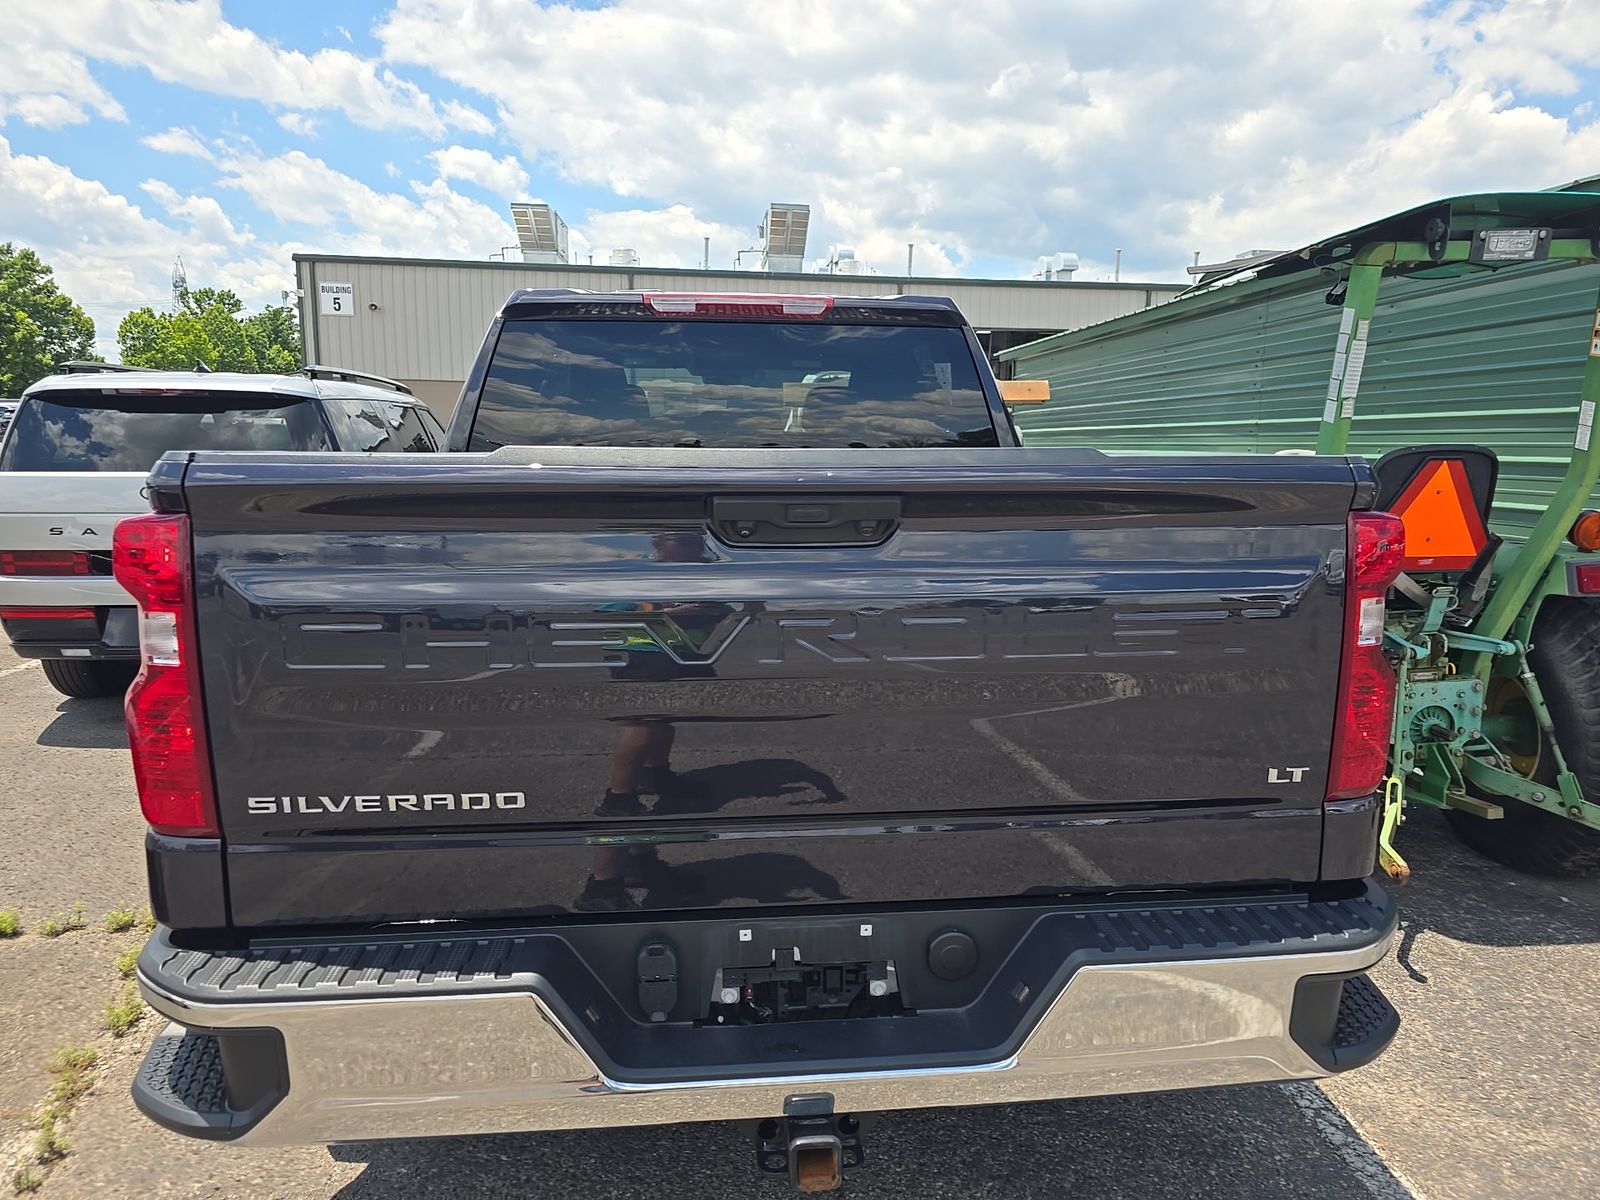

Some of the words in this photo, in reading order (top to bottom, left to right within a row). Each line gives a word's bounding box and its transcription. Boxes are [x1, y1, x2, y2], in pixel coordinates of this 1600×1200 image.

[321, 285, 352, 295] BUILDING
[333, 297, 341, 312] 5
[280, 605, 1292, 671] CHEVROLET
[1267, 767, 1311, 783] LT
[247, 791, 526, 814] SILVERADO
